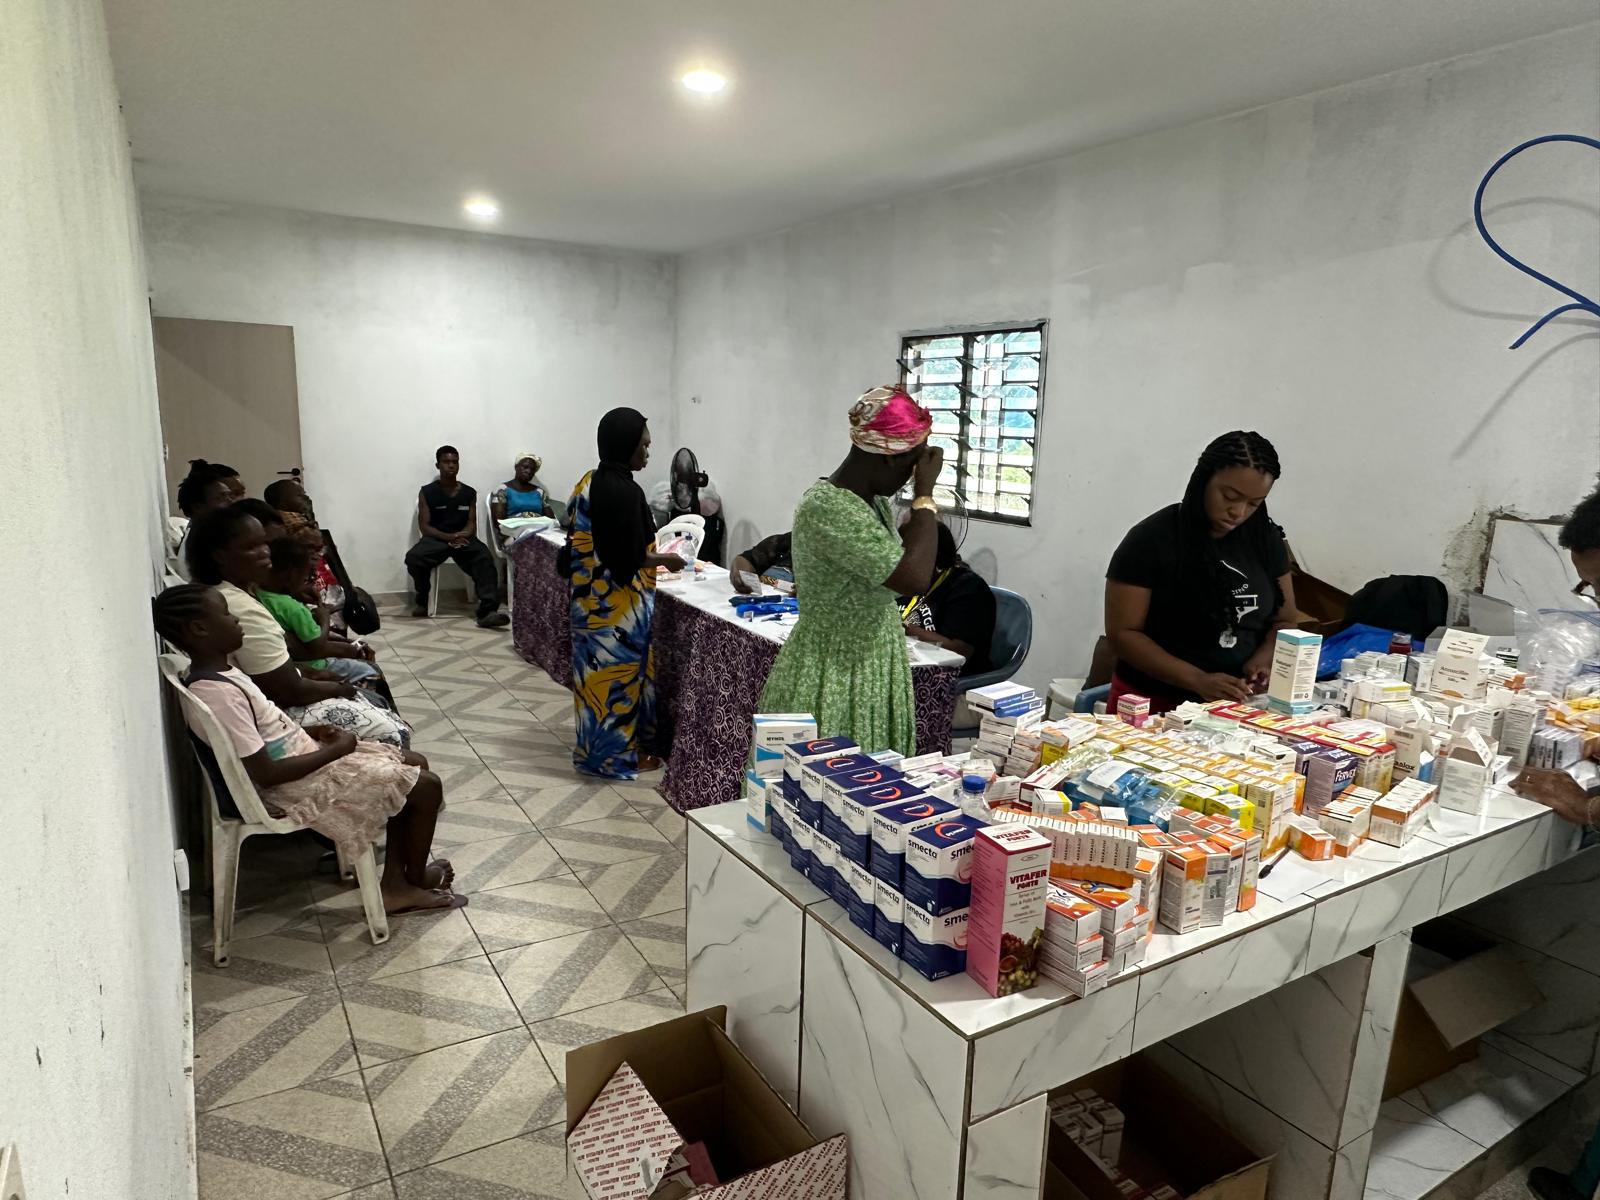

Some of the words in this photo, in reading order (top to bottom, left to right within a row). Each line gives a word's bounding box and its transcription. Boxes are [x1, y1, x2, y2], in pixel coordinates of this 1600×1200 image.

[802, 768, 821, 785] smecta
[842, 799, 865, 817] smecta
[873, 817, 898, 835] smecta
[992, 829, 1033, 840] VITAFER
[907, 839, 938, 859] smecta
[851, 866, 872, 885] smecta
[1010, 869, 1048, 885] VITAFER
[1017, 879, 1039, 890] FORTE
[877, 883, 900, 904] smecta
[906, 902, 930, 925] smecta
